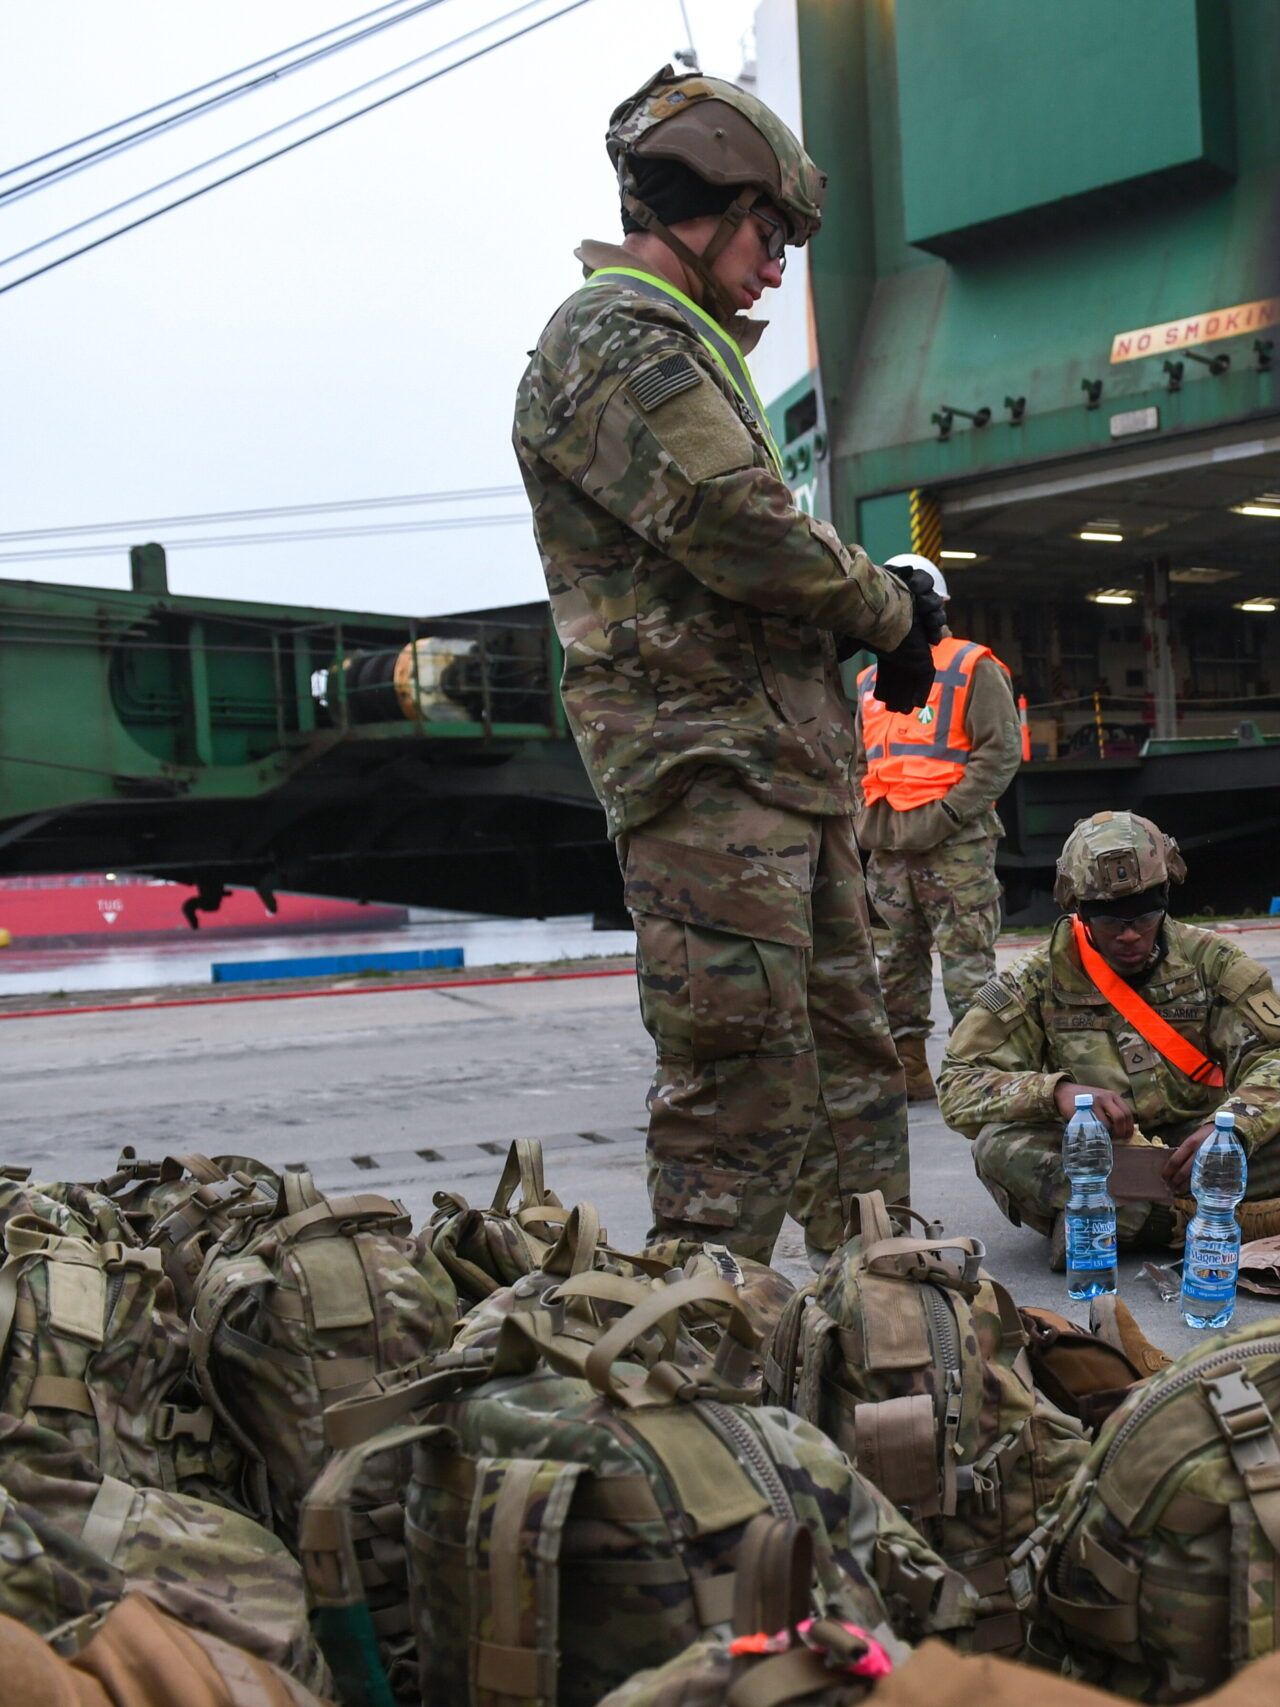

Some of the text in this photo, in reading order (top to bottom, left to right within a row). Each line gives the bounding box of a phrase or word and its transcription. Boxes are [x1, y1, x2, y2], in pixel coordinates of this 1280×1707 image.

[1117, 335, 1151, 357] NO
[97, 899, 124, 911] TUG
[1174, 1007, 1199, 1019] ARMY
[1262, 1001, 1280, 1018] 1
[1071, 1015, 1096, 1027] GRAY
